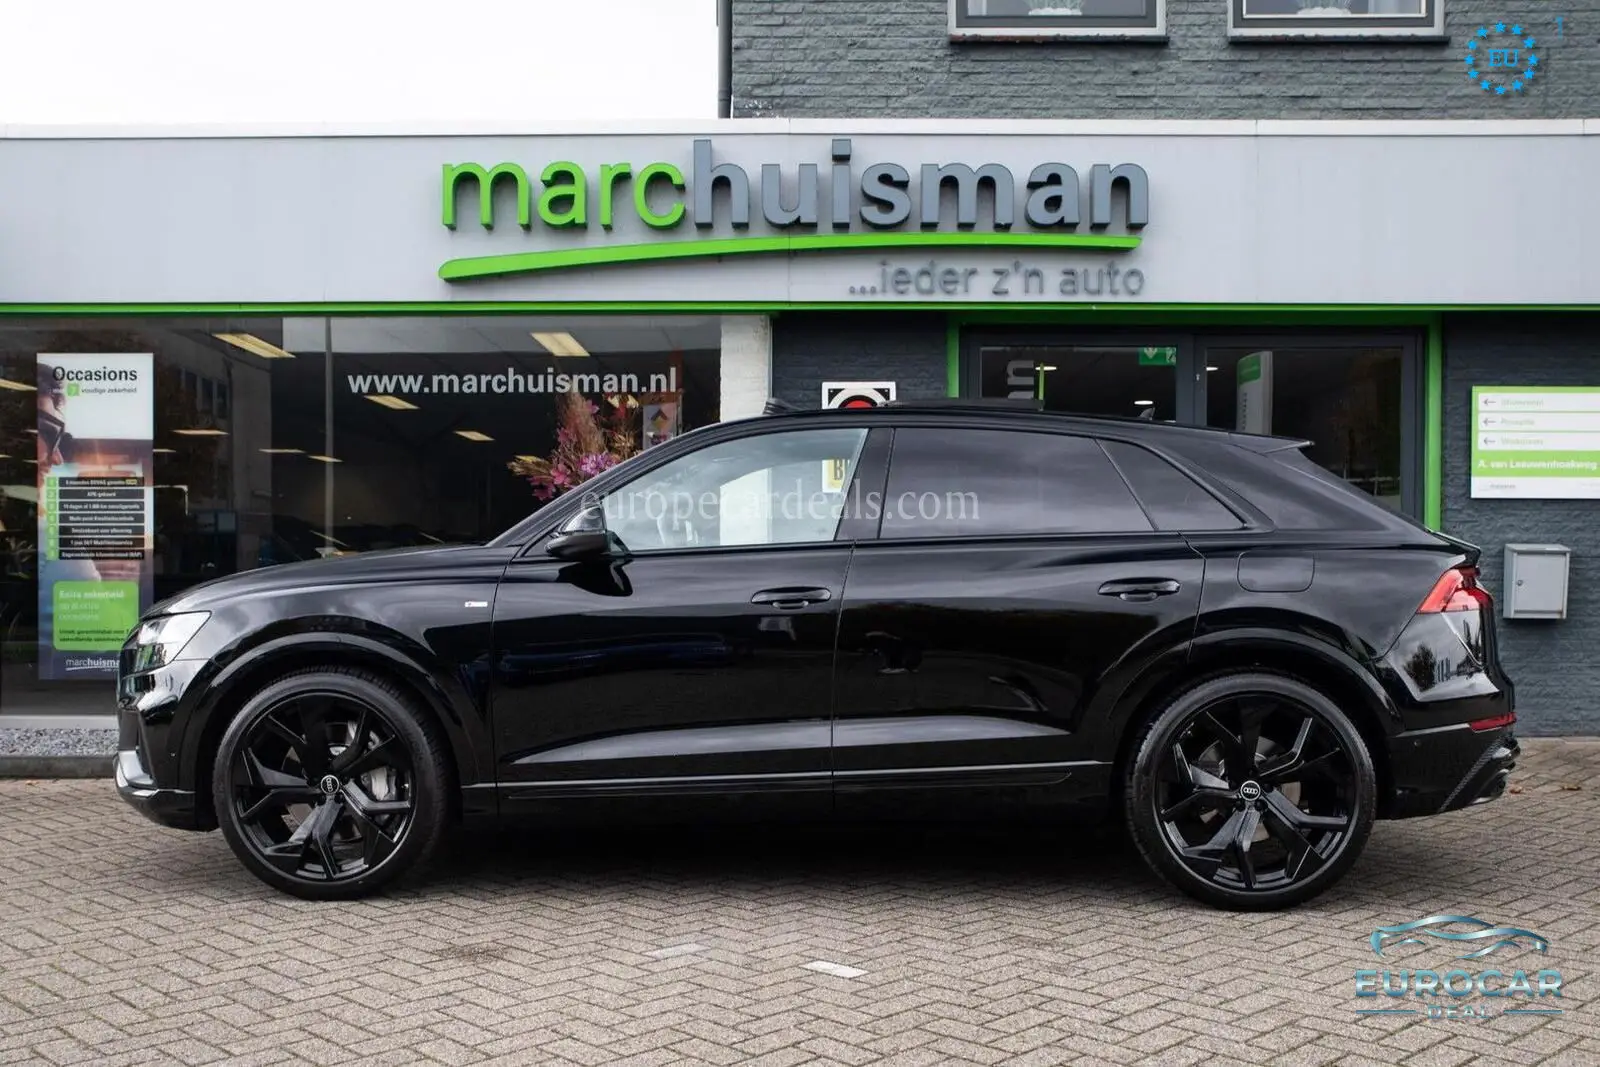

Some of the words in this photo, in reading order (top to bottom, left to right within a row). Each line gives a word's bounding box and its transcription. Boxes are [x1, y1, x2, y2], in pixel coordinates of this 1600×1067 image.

[441, 138, 1149, 230] marchuisman
[992, 260, 1044, 295] z'n
[1059, 260, 1145, 296] auto
[53, 366, 137, 381] Occasions
[348, 367, 677, 393] www.marchuisman.nl
[65, 658, 120, 667] marchuisma
